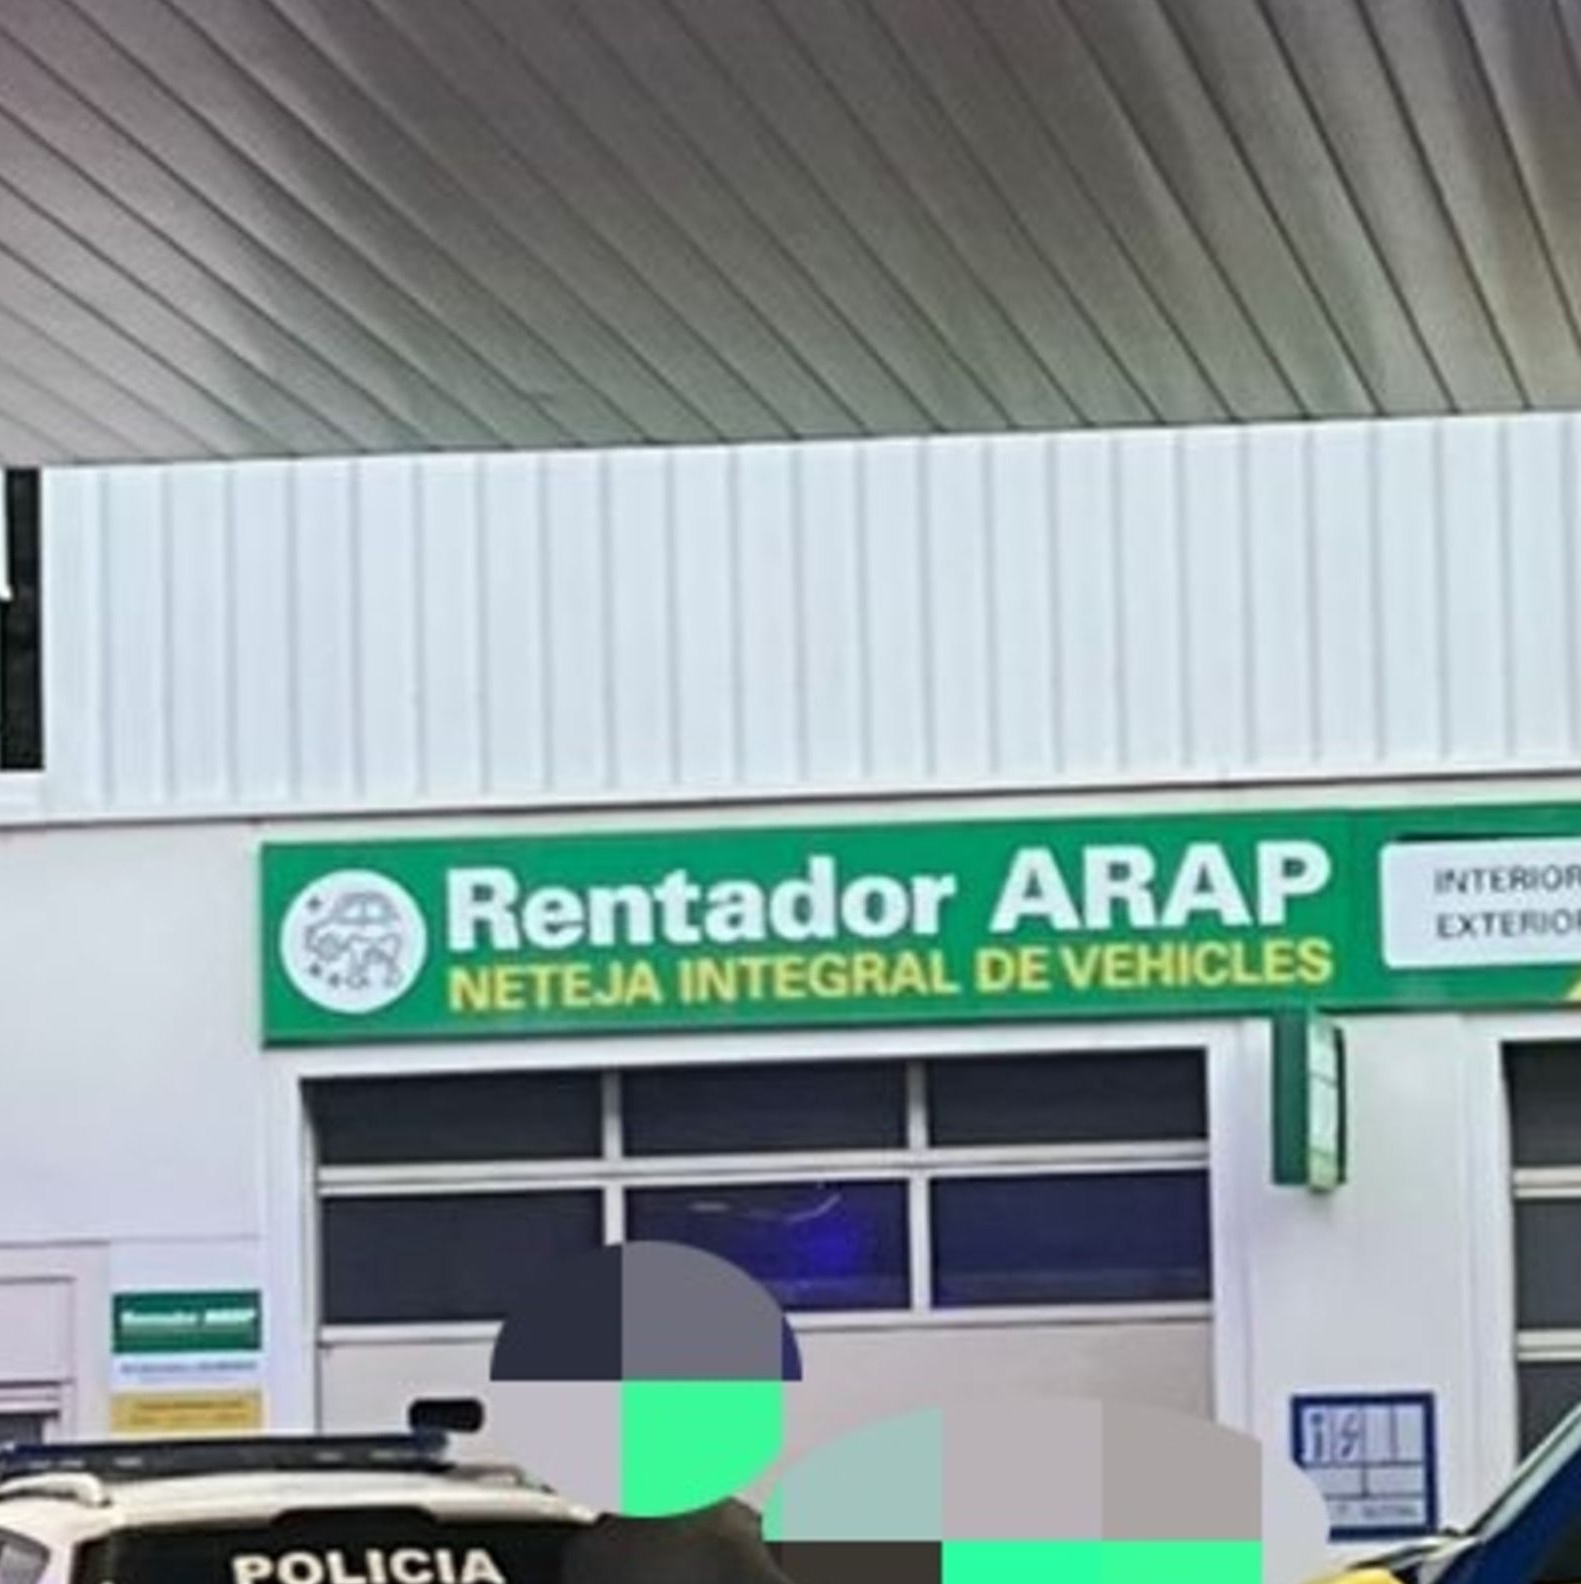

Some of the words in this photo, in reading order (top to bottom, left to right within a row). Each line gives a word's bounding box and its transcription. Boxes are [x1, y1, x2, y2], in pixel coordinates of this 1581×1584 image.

[446, 856, 958, 950] Rentador
[990, 840, 1332, 930] ARAP
[448, 964, 659, 1012] NETEJA
[680, 954, 959, 1005] INTEGRAL
[977, 948, 1048, 993] DE
[1060, 939, 1332, 990] VEHICLES
